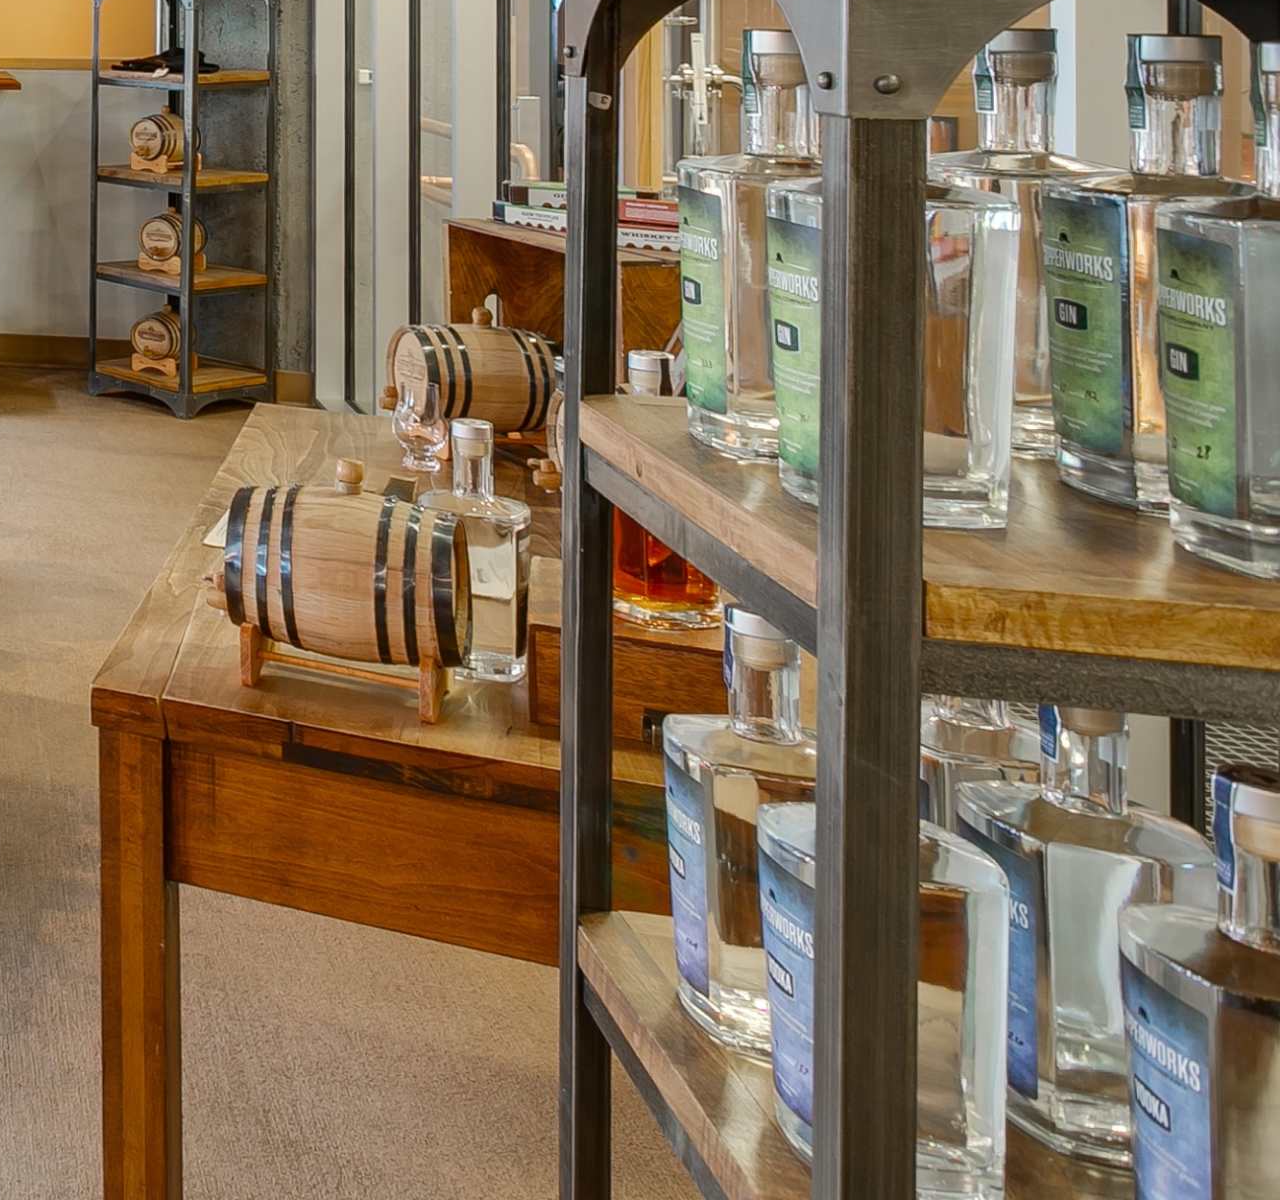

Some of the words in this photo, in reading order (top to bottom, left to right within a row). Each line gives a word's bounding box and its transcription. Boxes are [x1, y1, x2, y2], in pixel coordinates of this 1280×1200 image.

[1058, 302, 1078, 325] GIN
[1170, 348, 1188, 374] GIN
[1136, 1077, 1170, 1128] VODKA
